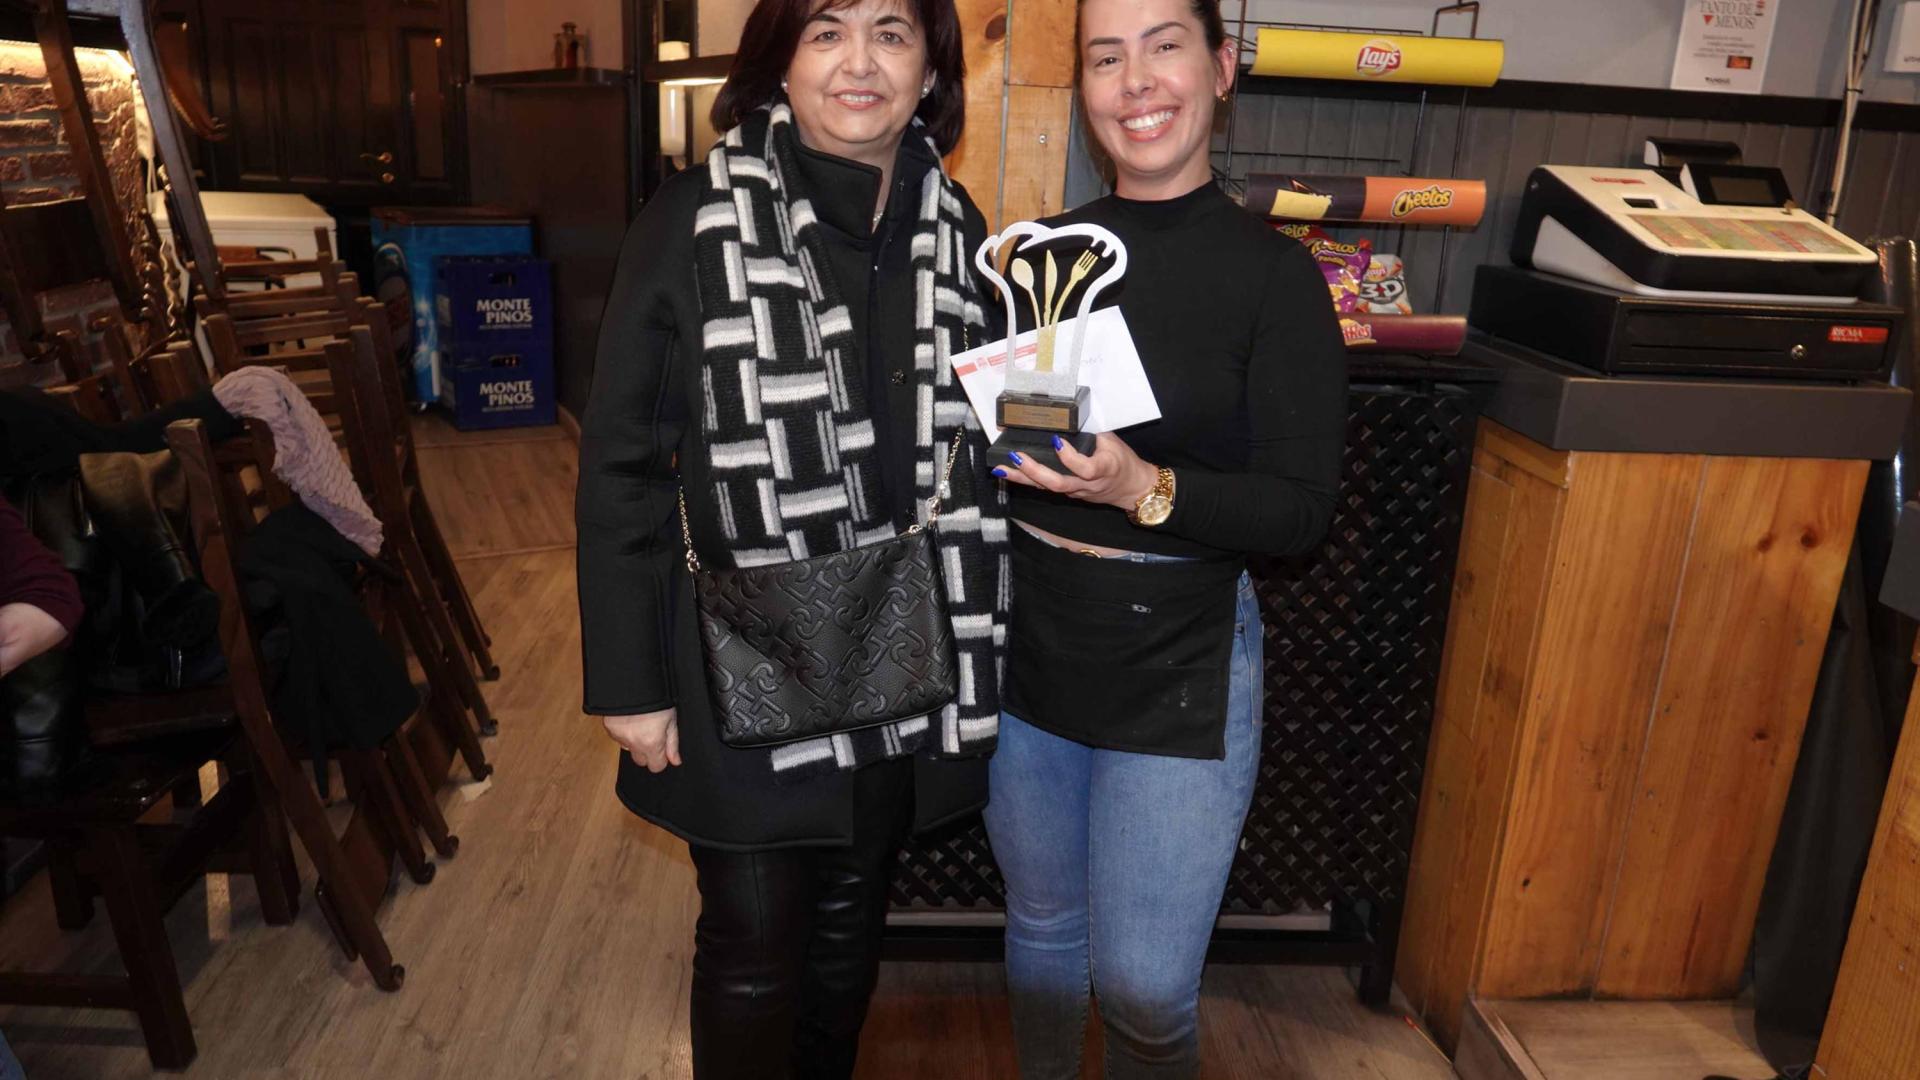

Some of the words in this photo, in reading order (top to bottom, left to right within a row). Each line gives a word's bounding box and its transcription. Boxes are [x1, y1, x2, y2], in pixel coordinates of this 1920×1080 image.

[1359, 47, 1400, 73] Lay's
[1392, 185, 1452, 217] Cheetos
[476, 298, 531, 312] MONTE
[486, 309, 533, 324] PINOS
[480, 381, 533, 395] MONTE
[489, 392, 534, 406] PINOS
